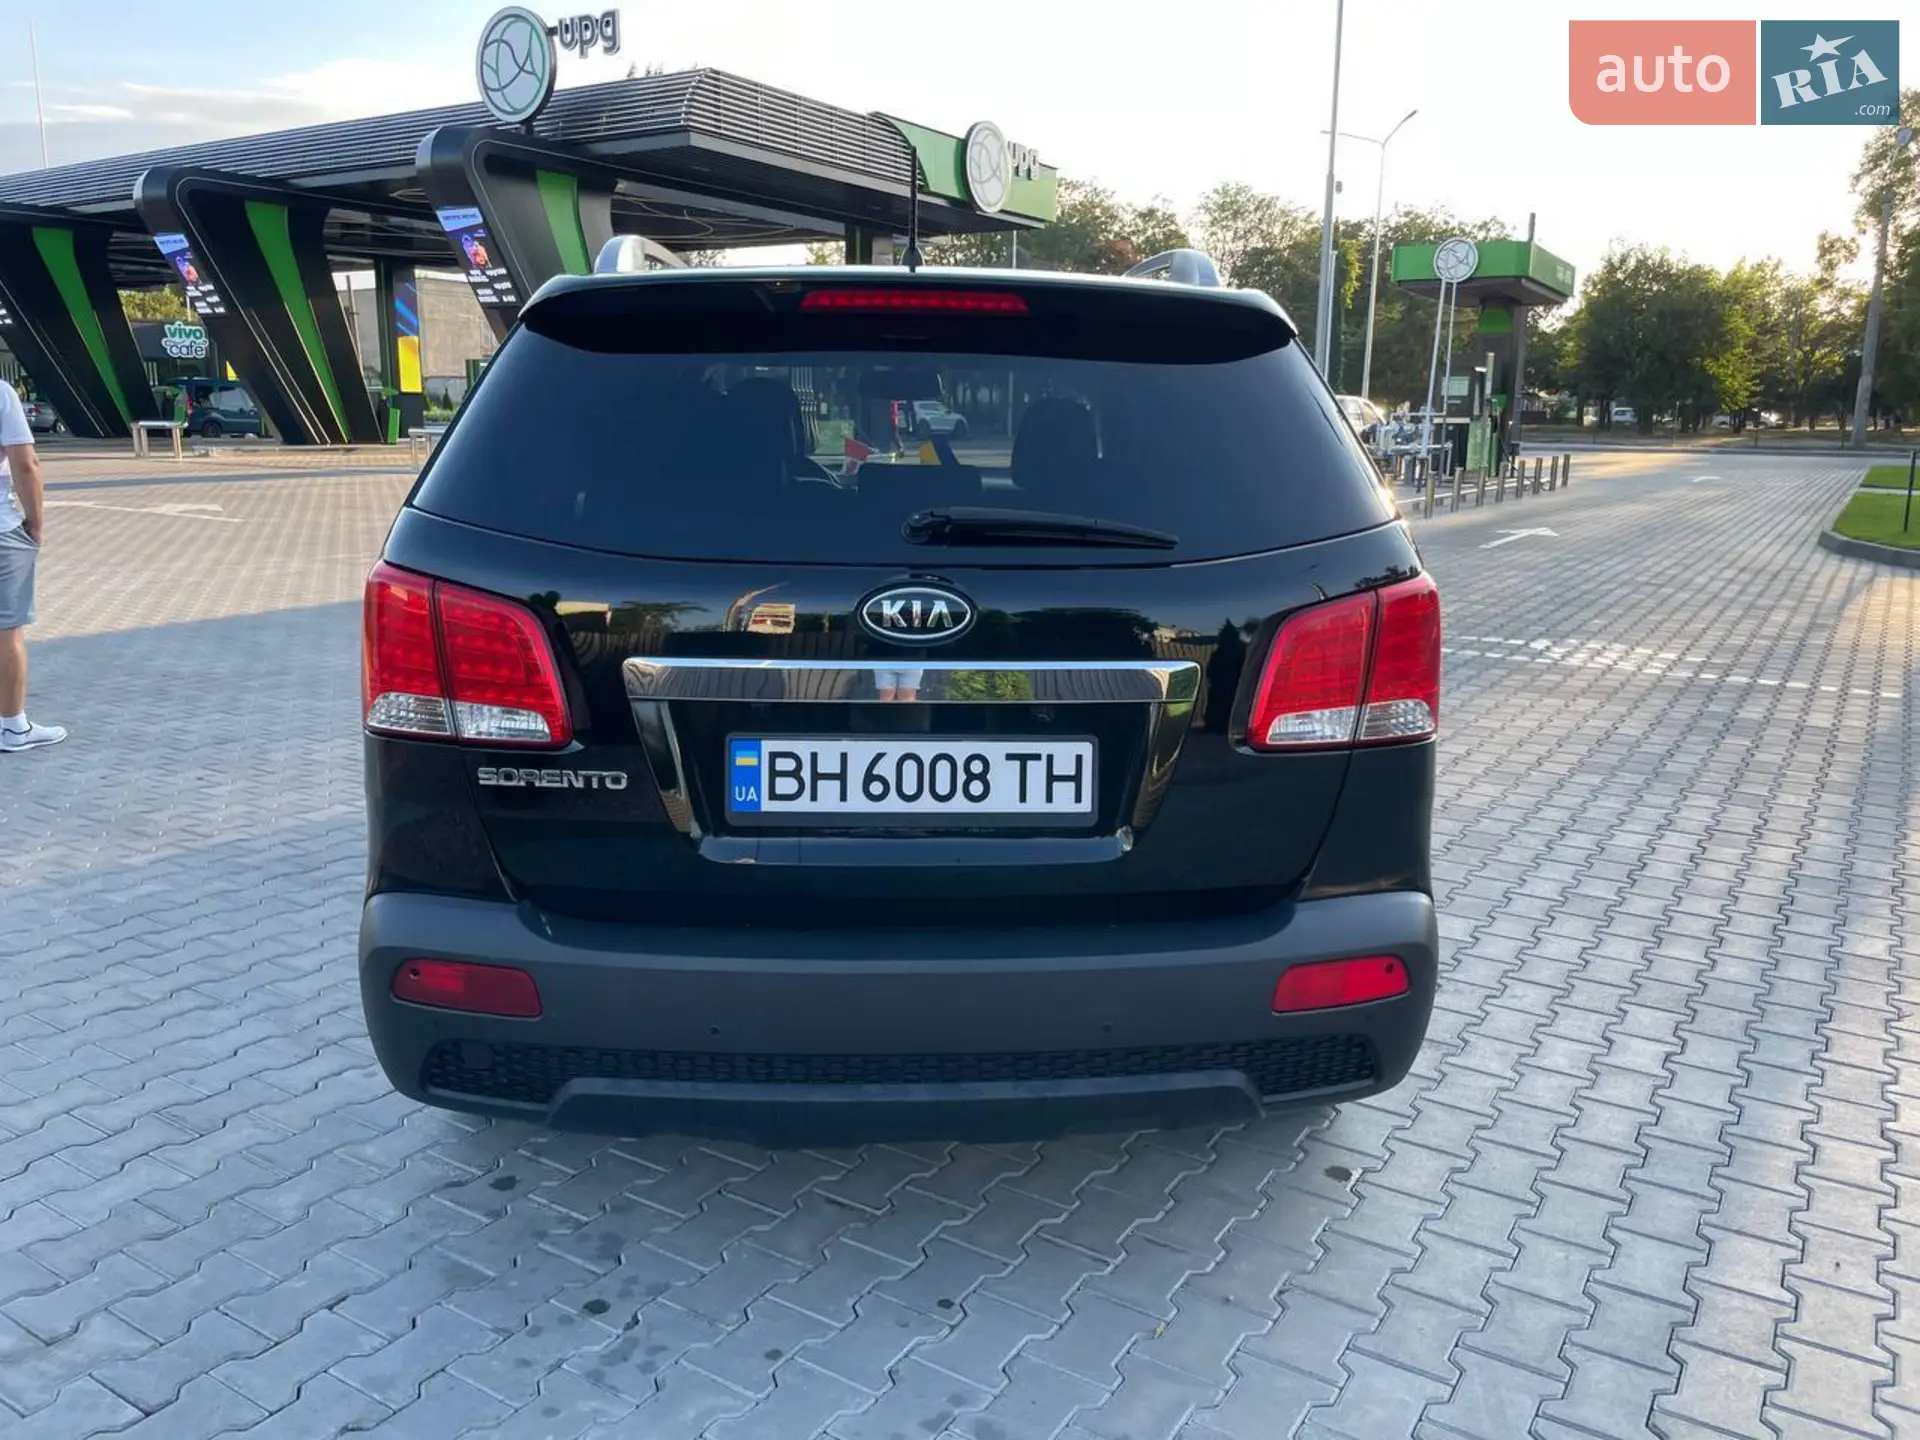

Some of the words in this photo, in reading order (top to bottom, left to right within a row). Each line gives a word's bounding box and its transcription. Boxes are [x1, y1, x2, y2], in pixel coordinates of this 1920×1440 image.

[558, 9, 620, 59] upg
[166, 322, 204, 340] vivo
[881, 600, 953, 627] KIA
[477, 767, 628, 790] SORENTO
[768, 751, 848, 802] BH
[862, 752, 991, 803] 6008
[1005, 753, 1083, 804] TH
[735, 786, 758, 801] UA
